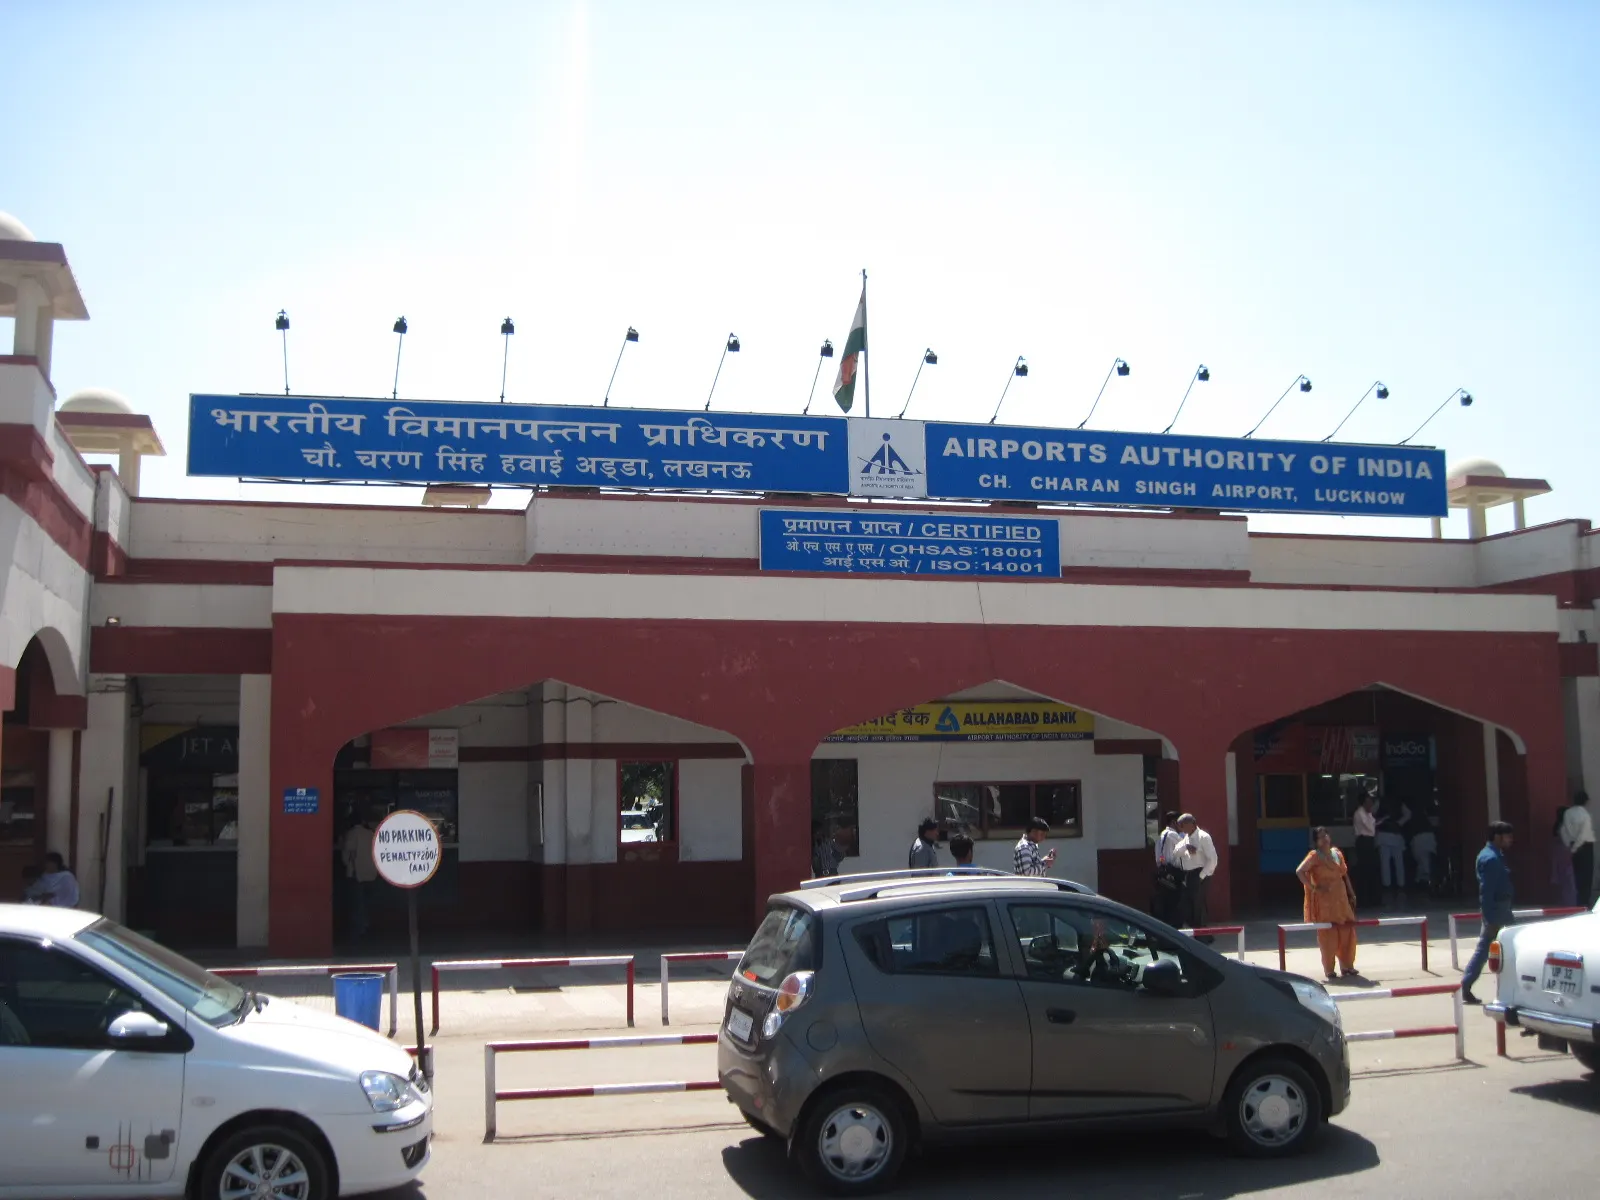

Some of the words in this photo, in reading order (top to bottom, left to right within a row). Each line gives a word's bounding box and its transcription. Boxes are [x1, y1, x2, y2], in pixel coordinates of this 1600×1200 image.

[210, 403, 367, 436] भारतीय
[384, 406, 622, 443] विमानपत्तन
[638, 417, 830, 451] प्राधिकरण
[301, 441, 342, 468] चौ.
[354, 450, 423, 470] चरण
[436, 445, 487, 473] सिंह
[500, 450, 564, 478] हवाई
[575, 455, 654, 482] अड्डा,
[661, 460, 753, 480] लखनऊ
[942, 437, 1107, 464] AIRPORTS
[1120, 445, 1297, 473] AUTHORITY
[1309, 455, 1346, 475] OF
[1358, 457, 1433, 480] INDIA
[978, 474, 1012, 489] CH.
[1030, 476, 1120, 493] CHARAN
[1135, 480, 1196, 496] SINGH
[1212, 483, 1298, 502] AIRPORT,
[1314, 488, 1406, 505] LUCKNOW
[782, 519, 852, 533] प्रमाणन
[859, 521, 902, 535] प्राप्त
[921, 523, 1041, 540] CERTIFIED
[902, 708, 930, 725] बैंक
[963, 712, 1040, 725] ALLAHABAD
[1043, 712, 1077, 724] BANK
[179, 736, 214, 760] JET
[378, 830, 390, 843] NO
[391, 829, 431, 842] PARKING
[380, 851, 416, 862] PENALTY
[409, 863, 430, 873] (AAI)
[1552, 967, 1561, 977] UP
[1546, 979, 1556, 990] AP
